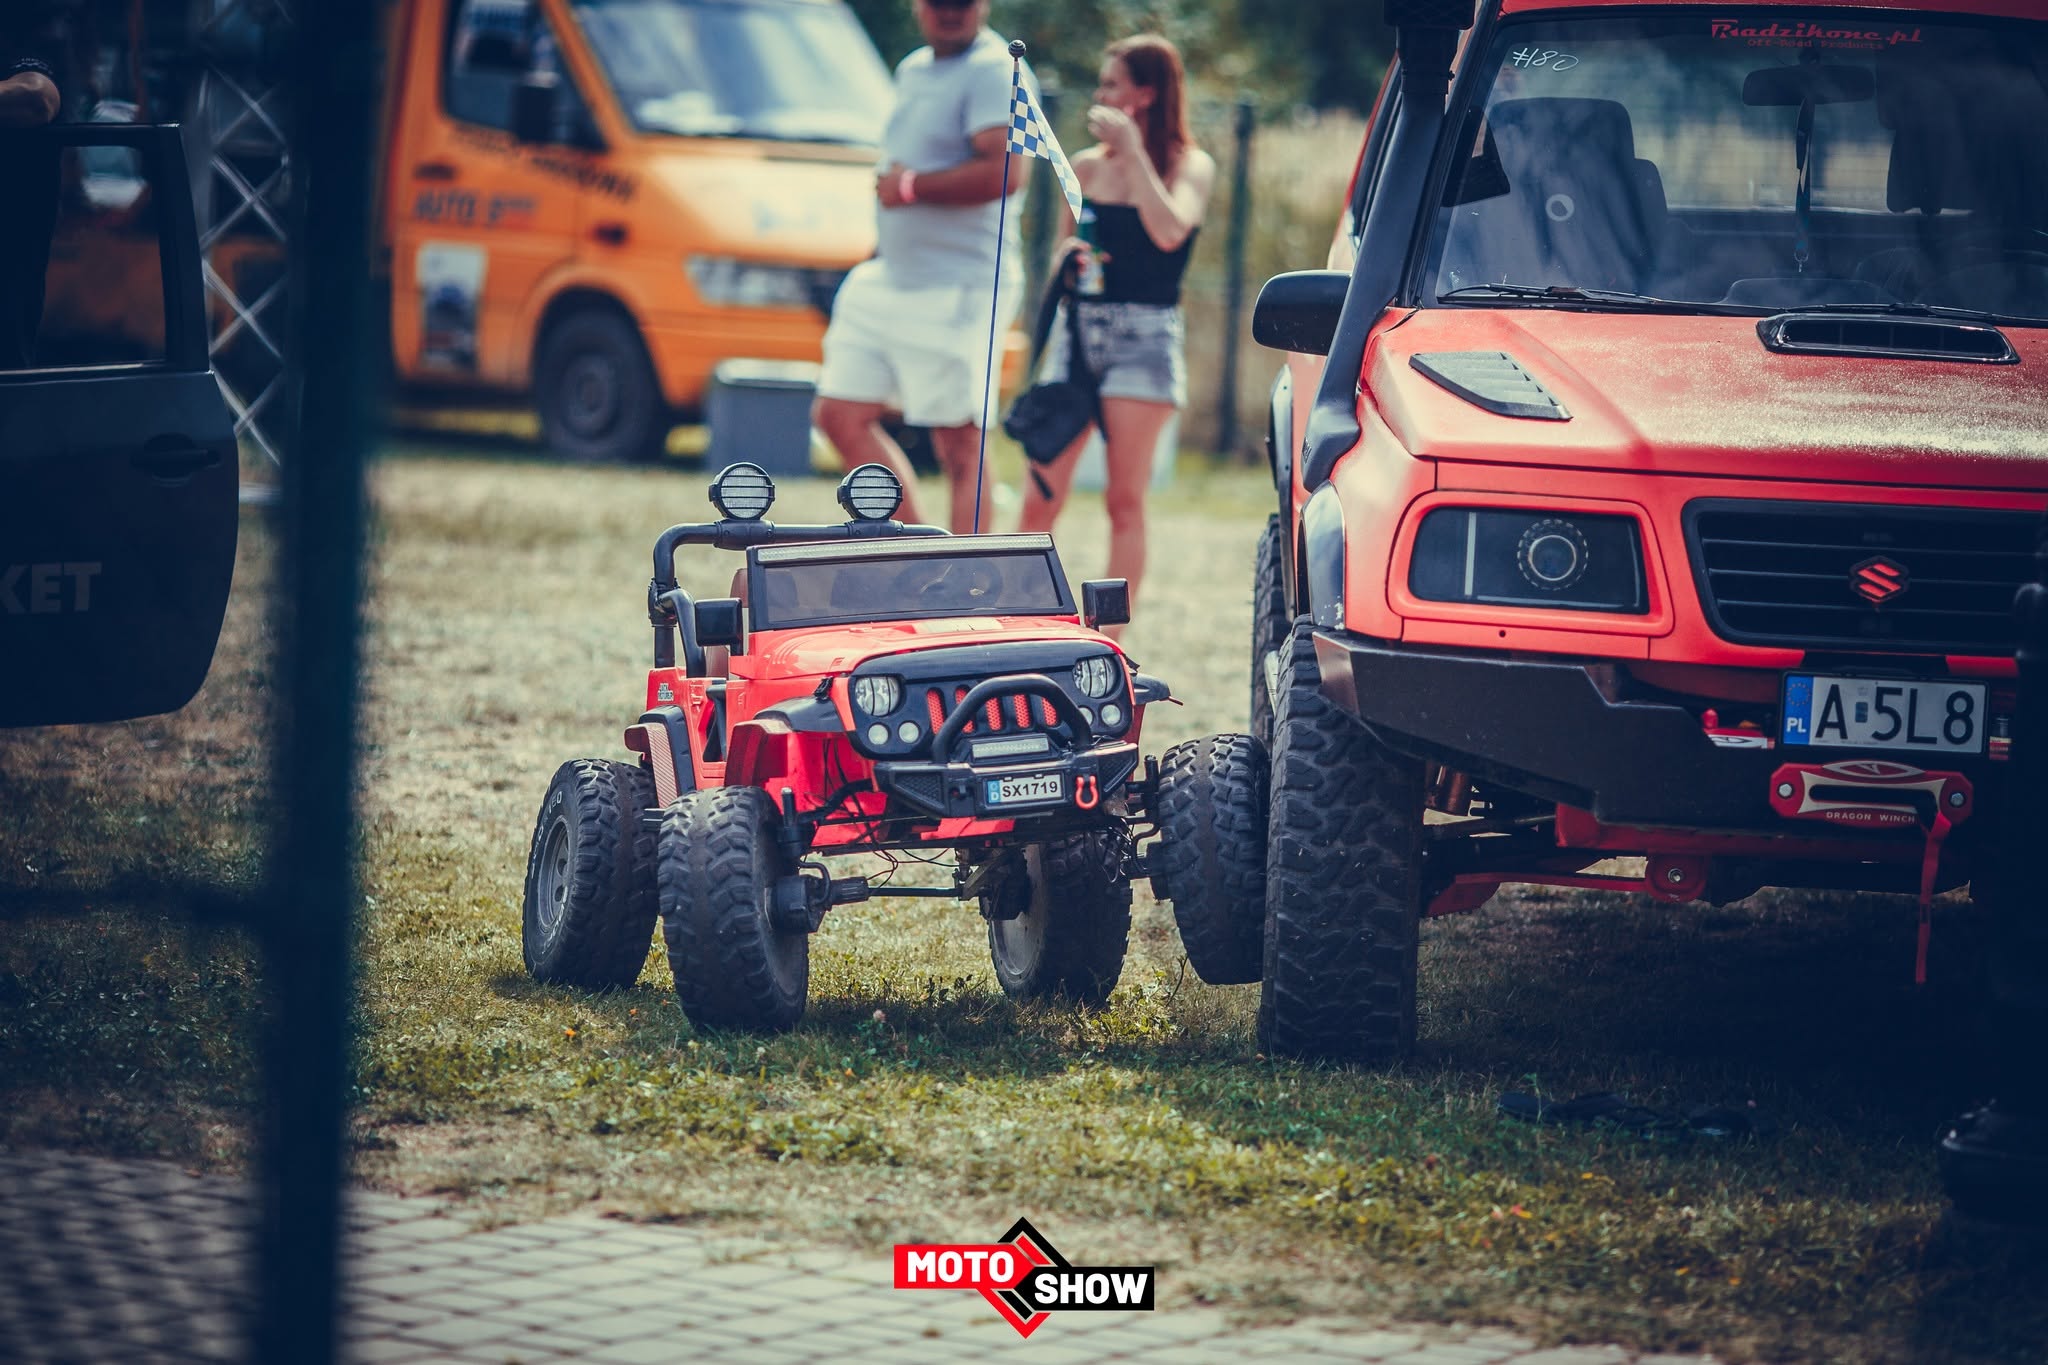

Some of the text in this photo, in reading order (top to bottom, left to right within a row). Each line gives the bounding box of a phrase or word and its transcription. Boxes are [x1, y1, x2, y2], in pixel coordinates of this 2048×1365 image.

[1747, 38, 1813, 49] Off-Road
[1786, 717, 1807, 733] PL
[1002, 781, 1057, 797] SX1719
[1826, 811, 1916, 823] DRAGON WINCH
